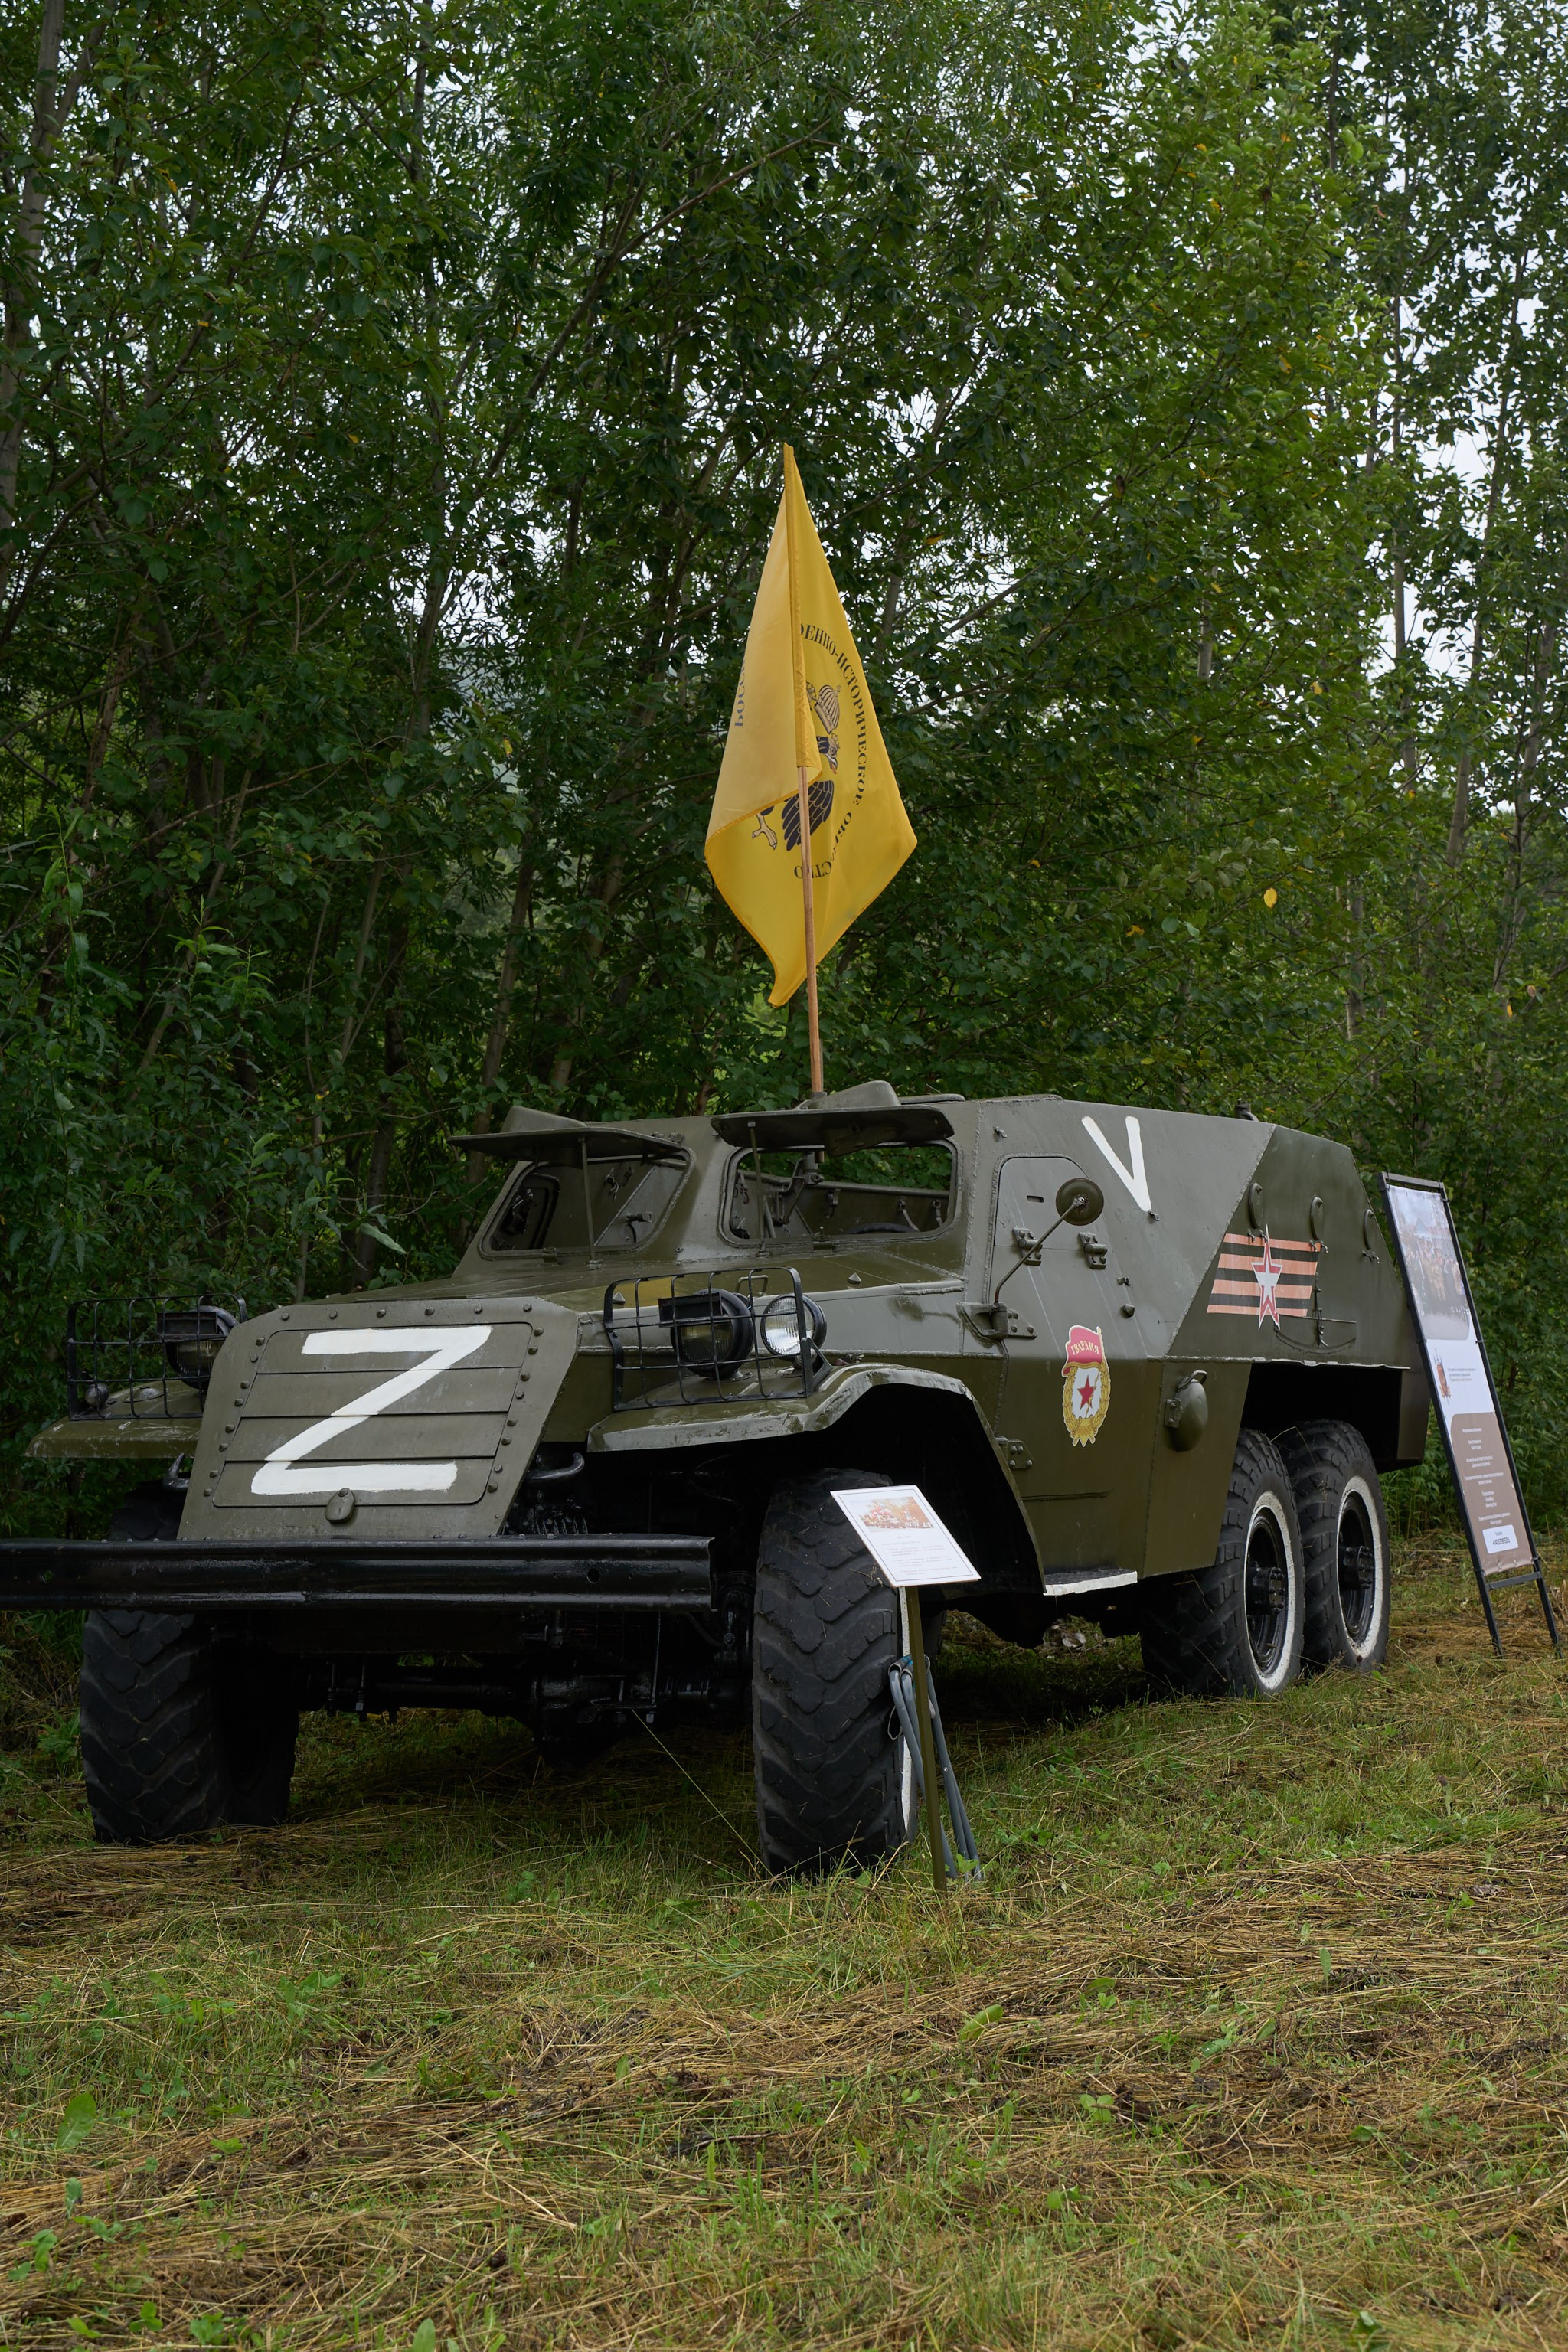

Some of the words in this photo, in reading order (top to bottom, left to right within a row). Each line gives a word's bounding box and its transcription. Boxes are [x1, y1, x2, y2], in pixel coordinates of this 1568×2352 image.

[1081, 1116, 1152, 1212] V
[1070, 1340, 1099, 1355] ГВАРДИЯ
[251, 1325, 494, 1495] Z
